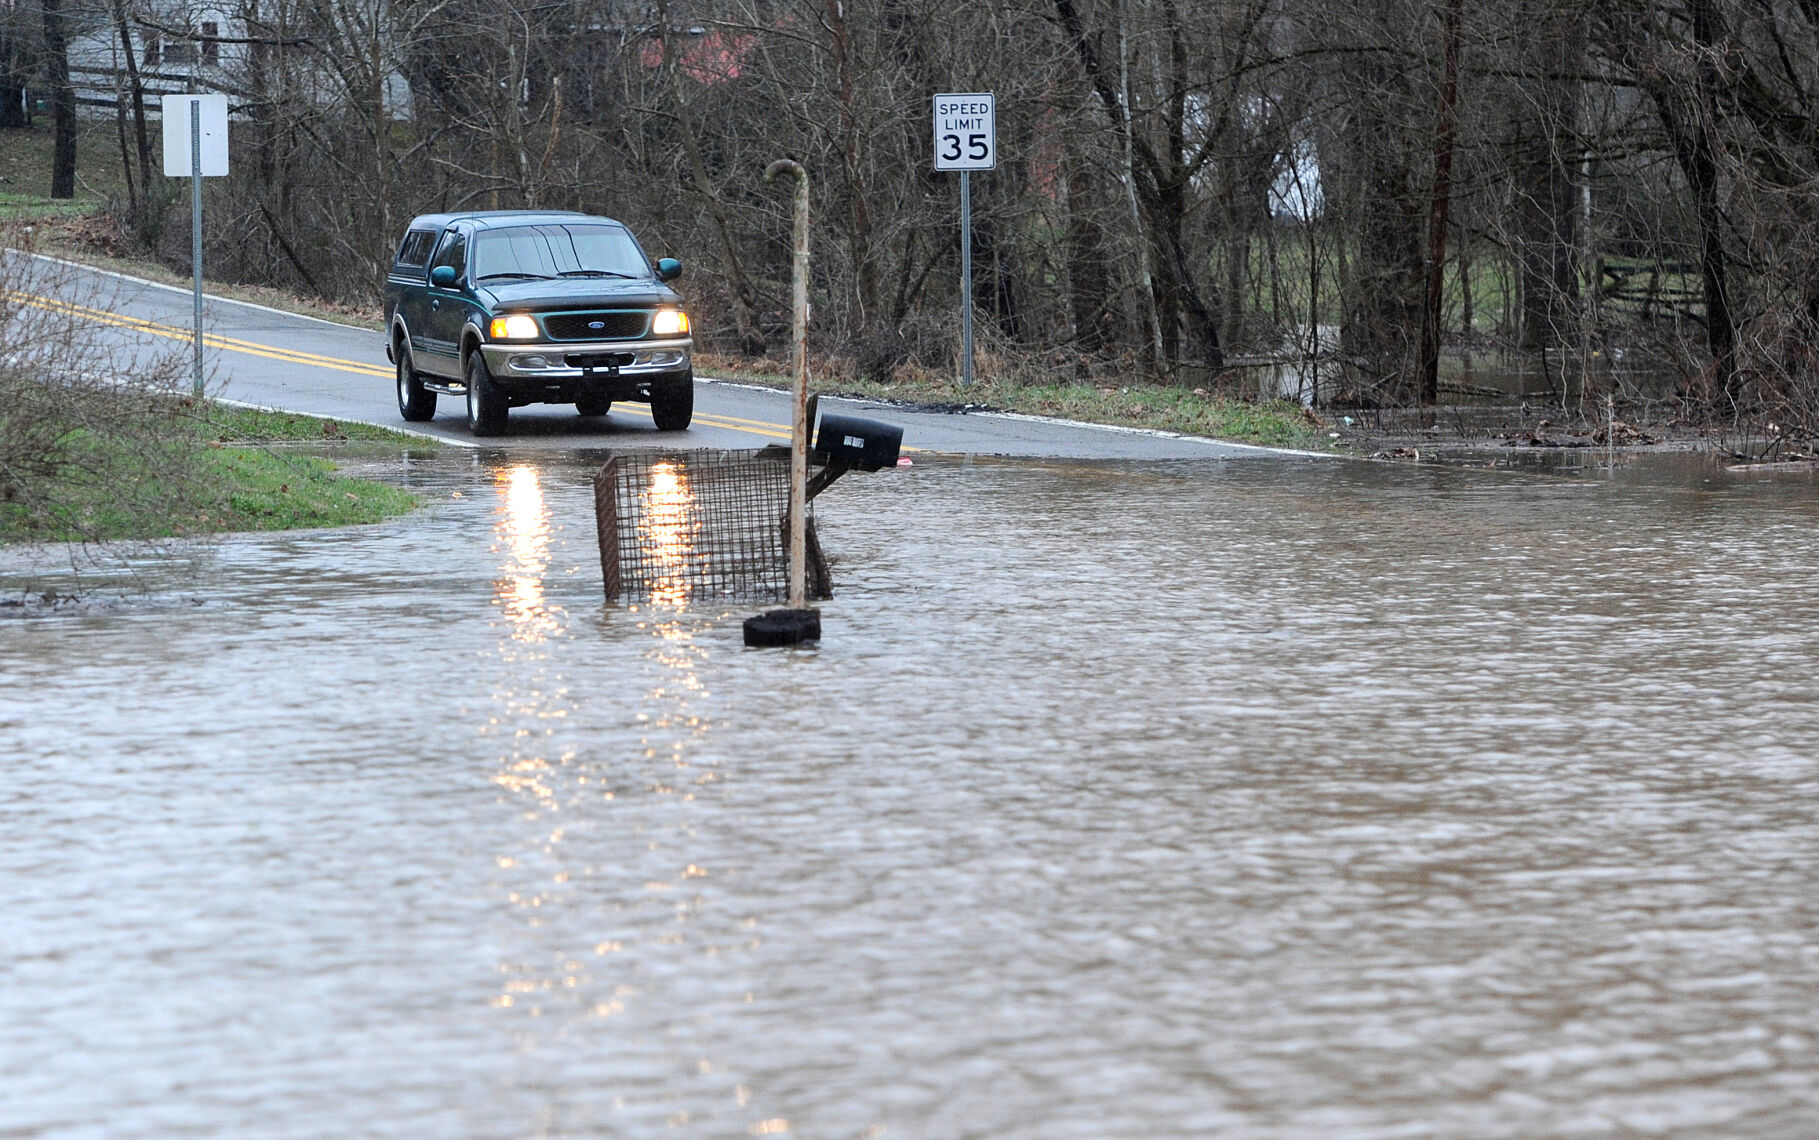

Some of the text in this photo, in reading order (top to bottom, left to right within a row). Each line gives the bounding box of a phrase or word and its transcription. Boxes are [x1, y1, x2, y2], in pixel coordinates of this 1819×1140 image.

[940, 103, 989, 115] SPEED
[945, 118, 983, 130] LIMIT
[942, 134, 989, 161] 35
